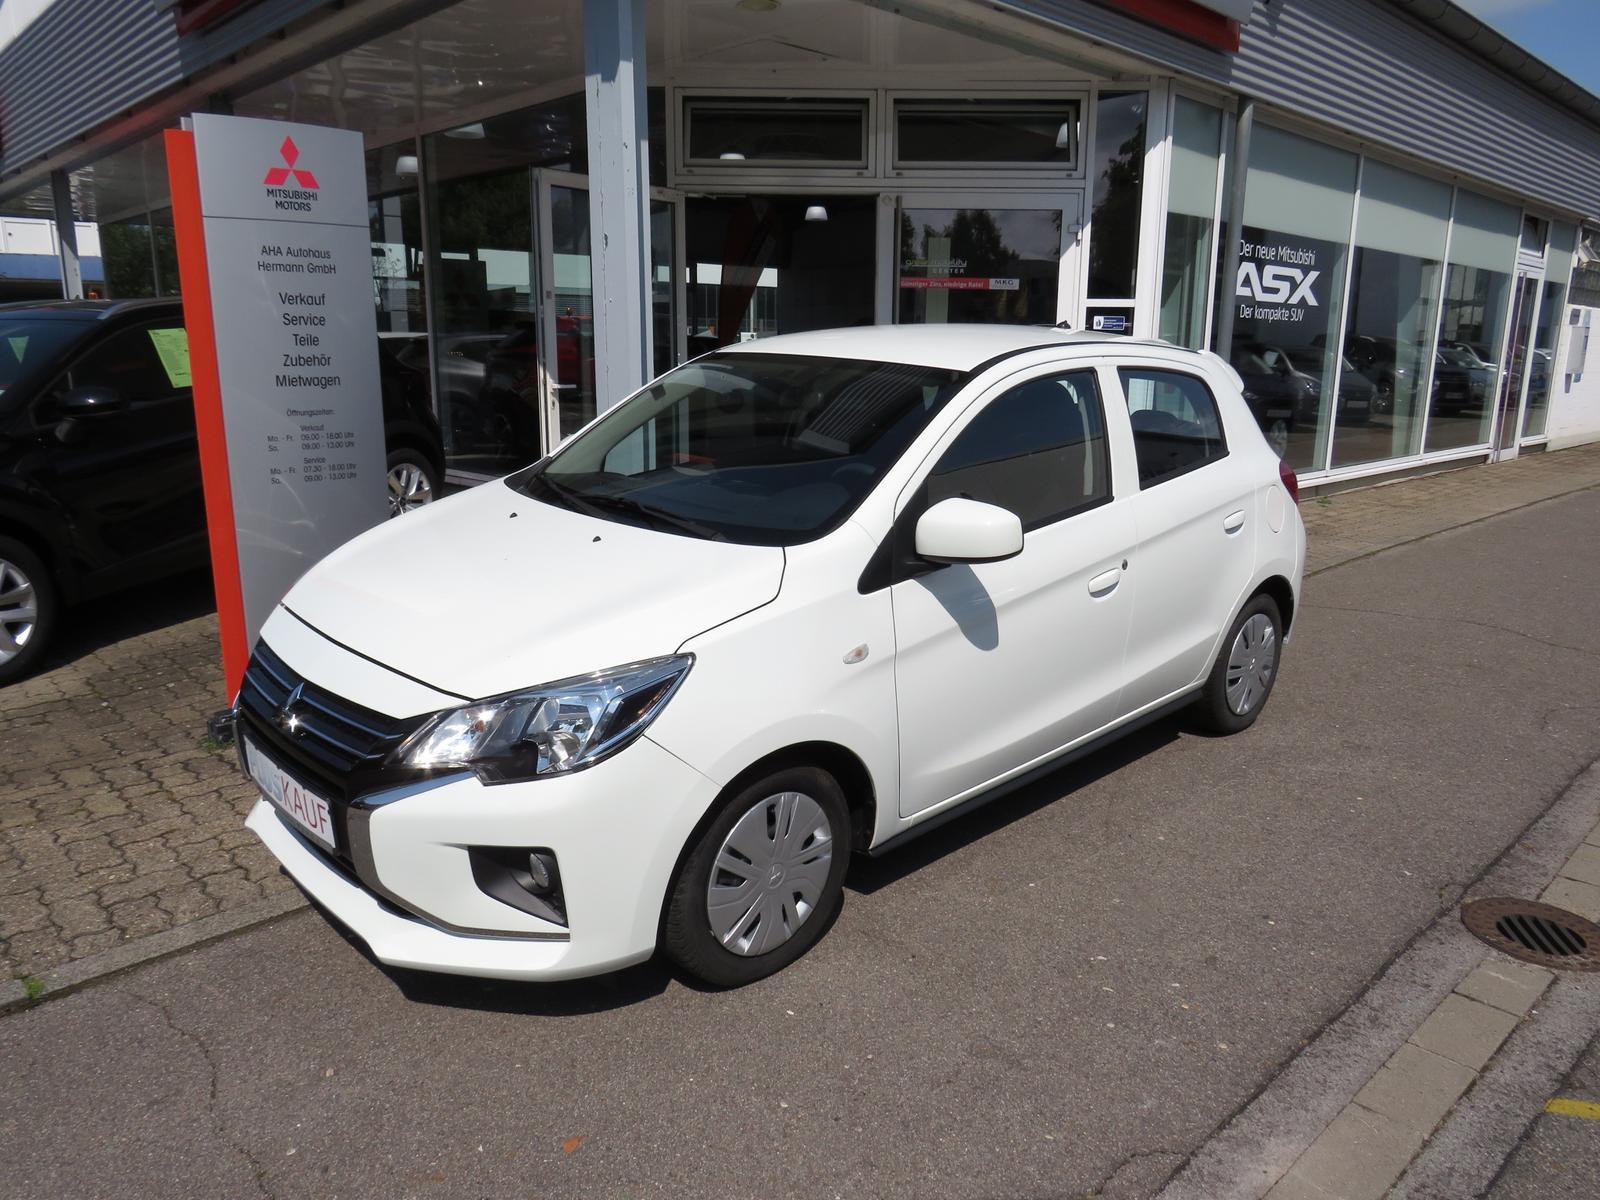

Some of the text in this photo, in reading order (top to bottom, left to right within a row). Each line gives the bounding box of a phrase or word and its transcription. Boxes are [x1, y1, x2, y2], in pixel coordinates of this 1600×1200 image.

[266, 188, 318, 201] MITSUBISHI
[275, 200, 311, 212] MOTORS
[261, 245, 331, 259] AHA Autohaus
[1240, 239, 1316, 266] Der neue Mitsubishi
[257, 260, 337, 274] Hermann GmbH
[1236, 261, 1320, 306] ASX
[279, 292, 326, 306] Verkauf
[282, 312, 326, 327] Service
[1240, 304, 1304, 323] Der kompakte SUV
[292, 333, 320, 347] Teile
[283, 353, 332, 367] Zubehör
[275, 374, 341, 390] Mietwagen
[300, 424, 325, 432] Verkauf
